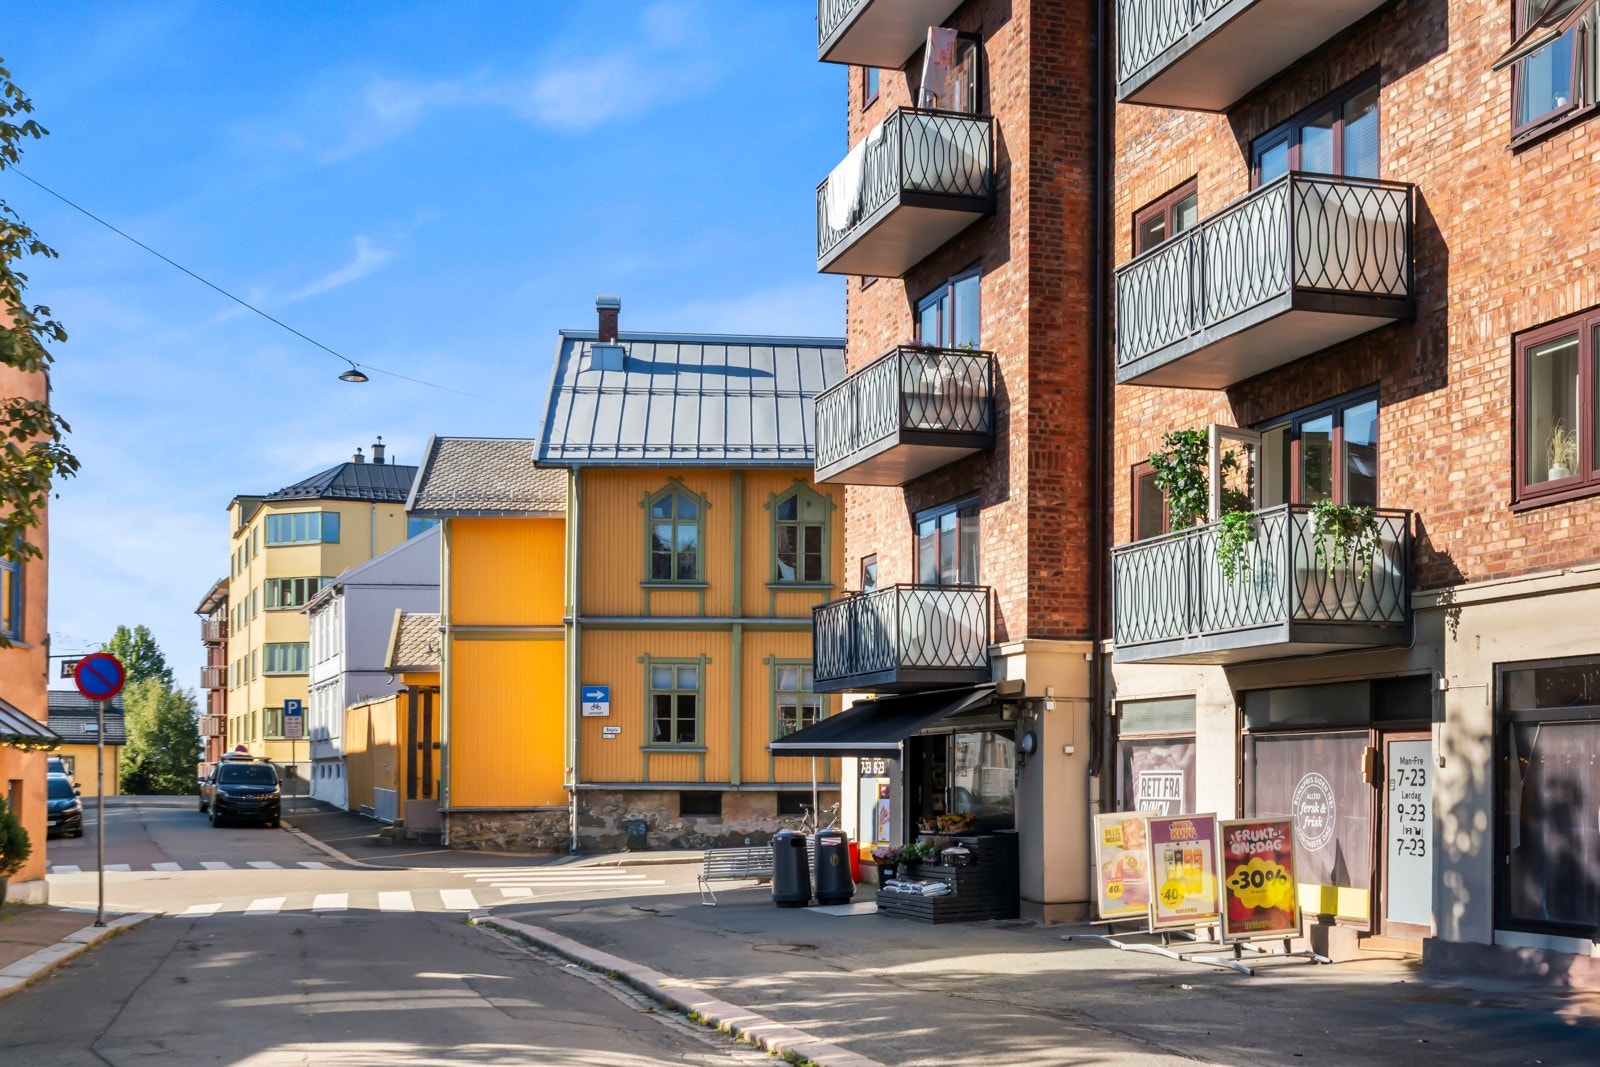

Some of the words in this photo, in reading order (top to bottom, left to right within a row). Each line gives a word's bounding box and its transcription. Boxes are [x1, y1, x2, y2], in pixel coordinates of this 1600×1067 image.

[288, 701, 298, 714] P
[1400, 757, 1423, 765] Man-Fre
[1397, 769, 1426, 786] 7-23
[1141, 778, 1161, 797] RETT
[1163, 777, 1180, 798] FRA
[1402, 791, 1421, 801] Lørdag
[1300, 802, 1320, 815] fersk
[1320, 803, 1327, 814] &
[1397, 804, 1426, 822] 9-23
[1302, 815, 1323, 829] frisk
[1231, 840, 1282, 855] ONSDAG
[1397, 838, 1426, 857] 7-23
[1232, 869, 1287, 889] -30%
